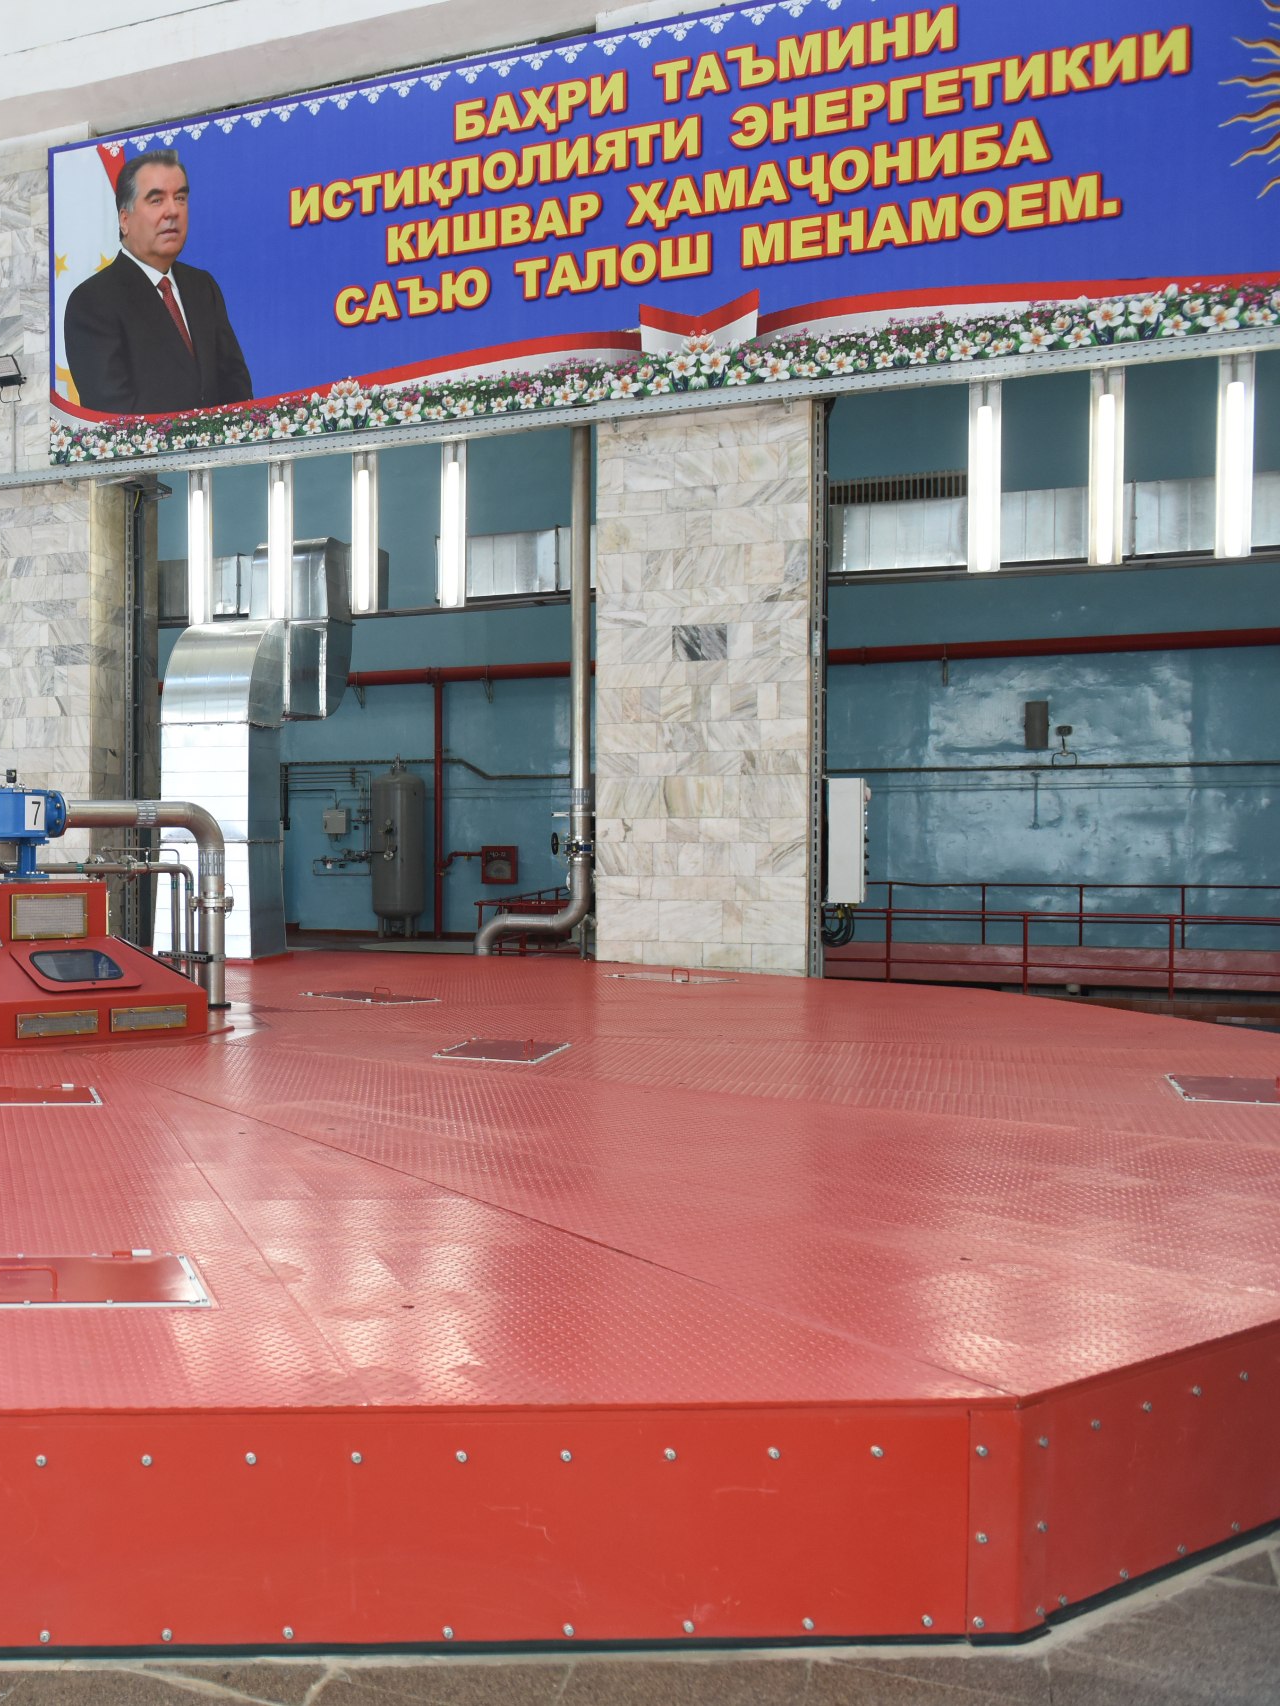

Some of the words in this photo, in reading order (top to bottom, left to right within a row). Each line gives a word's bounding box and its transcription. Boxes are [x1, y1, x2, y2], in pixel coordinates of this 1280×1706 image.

[291, 116, 700, 227] ИСТИҚЛОЛИЯТИ
[731, 28, 1188, 149] ЭНЕРГЕТИКИИ
[455, 72, 626, 142] БАҲРИ
[654, 7, 956, 103] ТАЪМИНИ
[335, 269, 490, 326] САЪЮ
[515, 234, 710, 300] ТАЛОШ
[743, 174, 1120, 268] МЕНАМОЕМ.
[387, 194, 601, 265] КИШВАР
[628, 120, 1049, 230] ҲАМАҶОНИБА
[31, 800, 41, 826] 7
